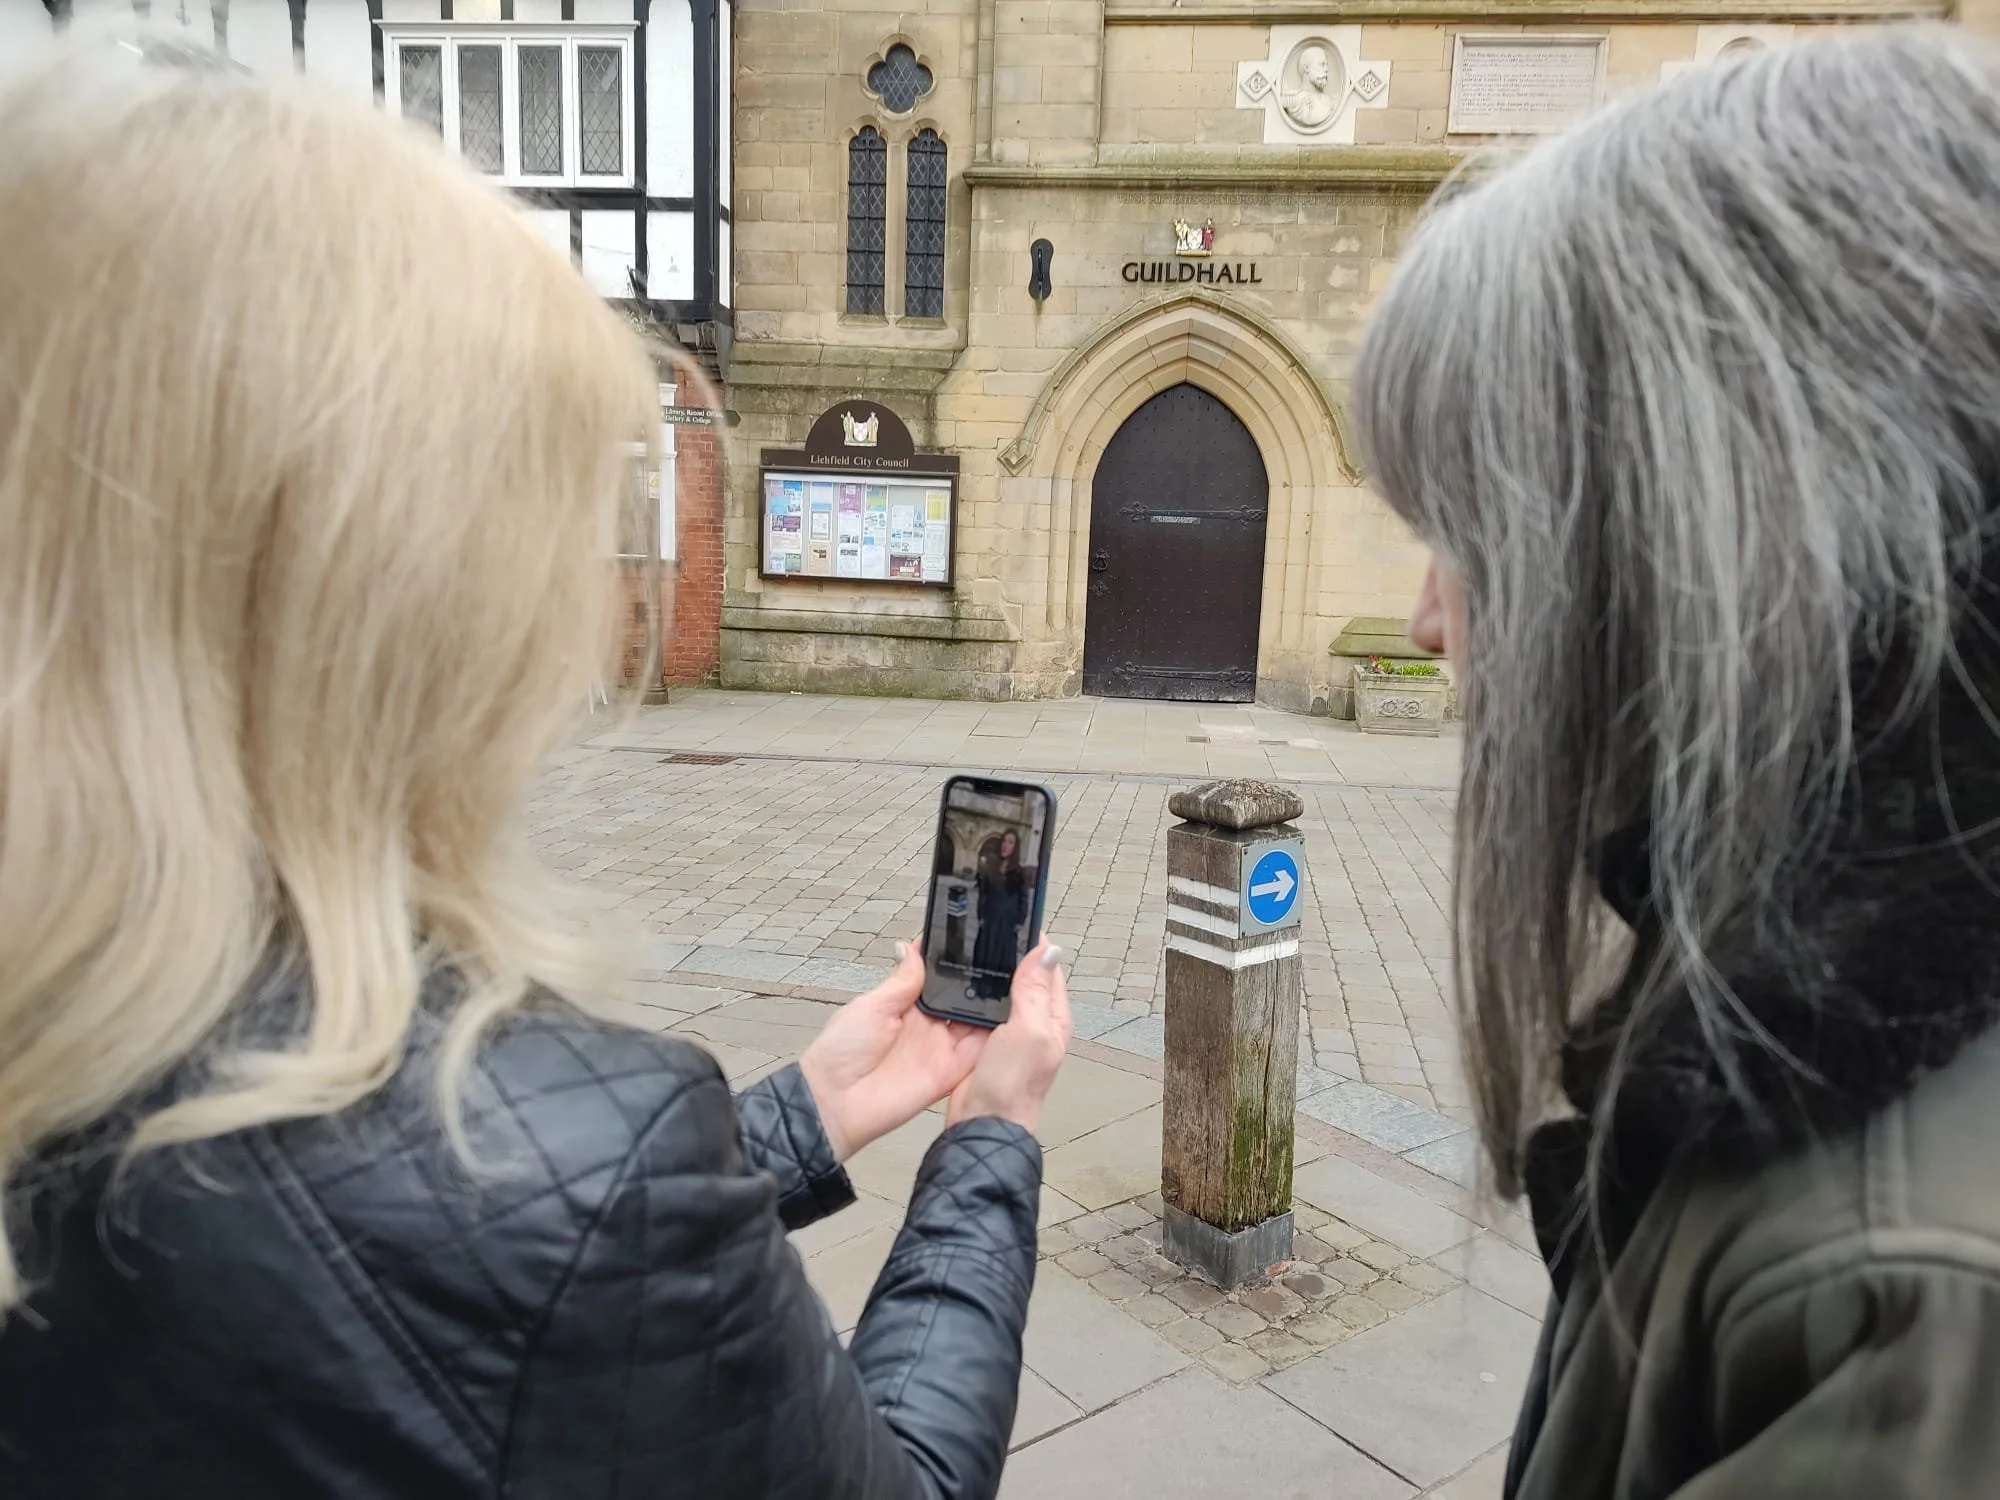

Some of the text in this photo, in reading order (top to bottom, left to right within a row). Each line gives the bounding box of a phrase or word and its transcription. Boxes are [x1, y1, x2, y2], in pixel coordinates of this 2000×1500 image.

[1121, 262, 1263, 283] GUILDHALL
[810, 454, 909, 468] Lichfield City Council
